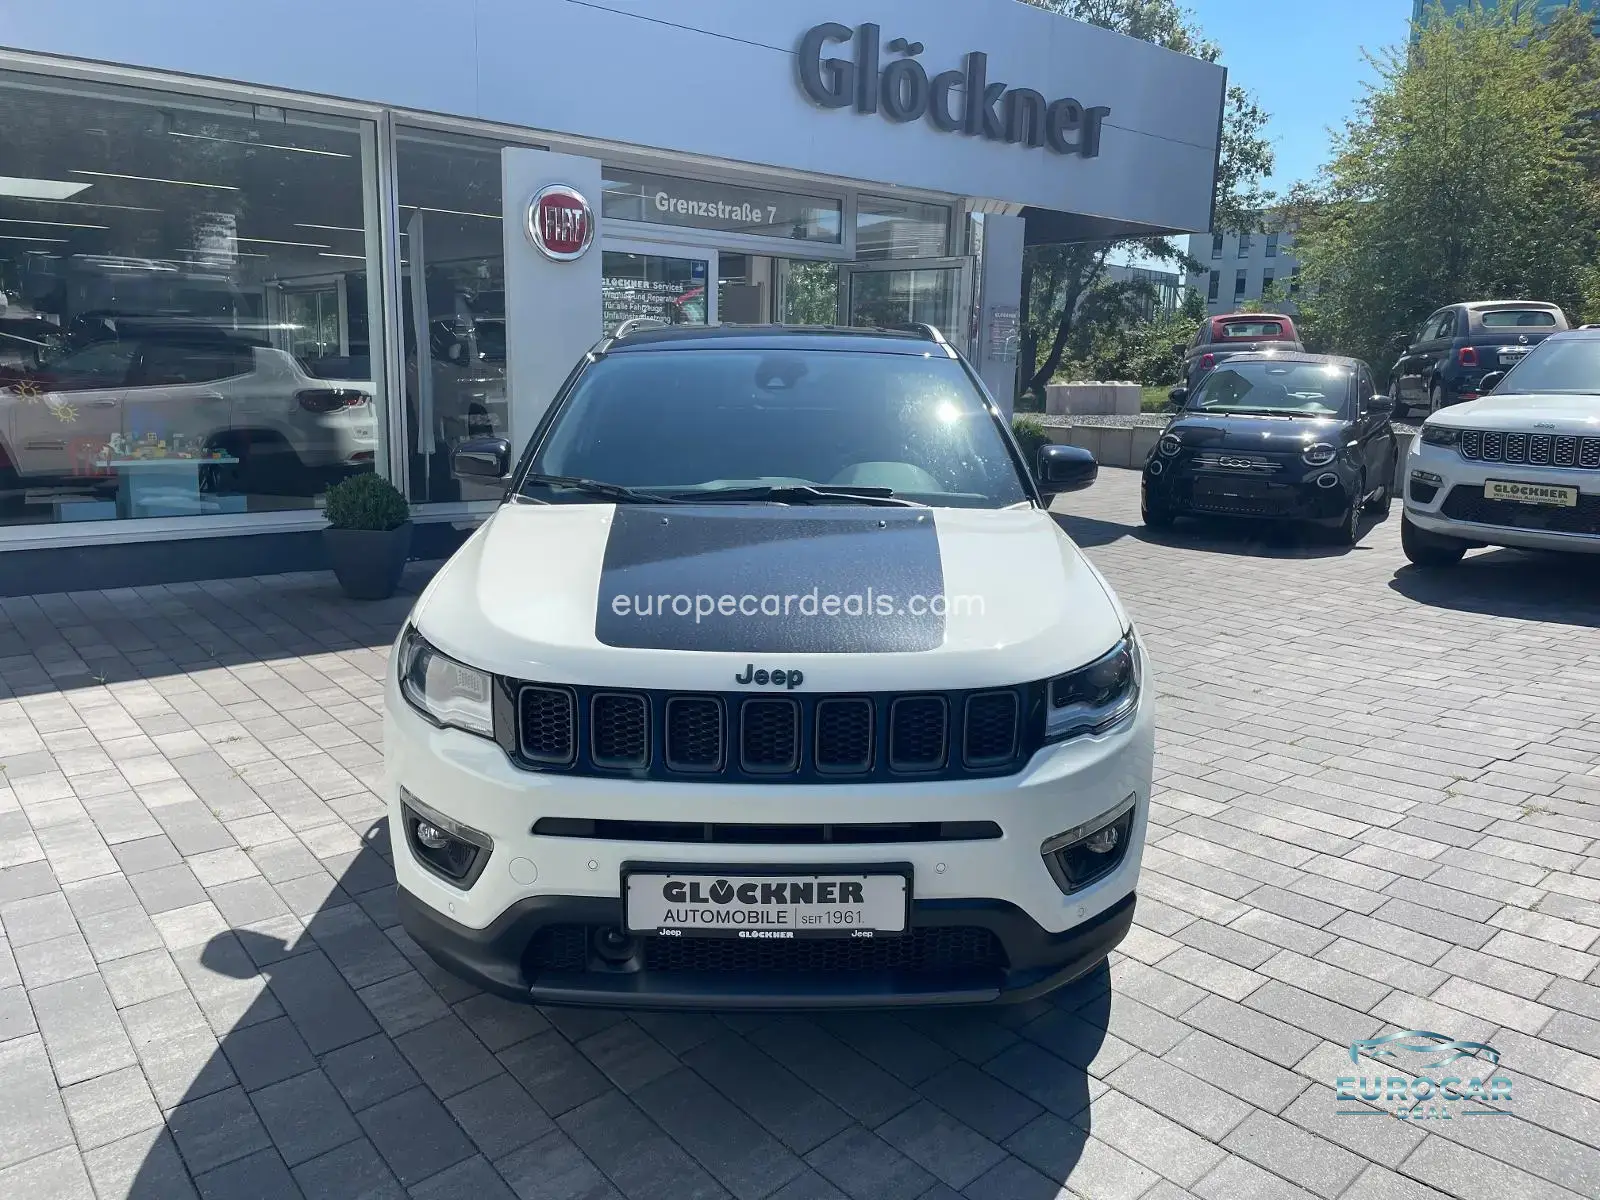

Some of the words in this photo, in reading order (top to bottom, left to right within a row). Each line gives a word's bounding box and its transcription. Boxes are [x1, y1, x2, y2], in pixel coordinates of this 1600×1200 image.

[797, 22, 1110, 158] Glöckner
[655, 191, 762, 223] Grenzstraße
[767, 205, 777, 224] 7
[544, 206, 583, 243] FIAT
[653, 281, 683, 292] Services
[735, 663, 804, 690] Jeep
[663, 909, 788, 924] AUTOMOBILE
[801, 915, 823, 924] SEIT
[659, 928, 682, 937] Jeep
[851, 929, 874, 938] Jeep
